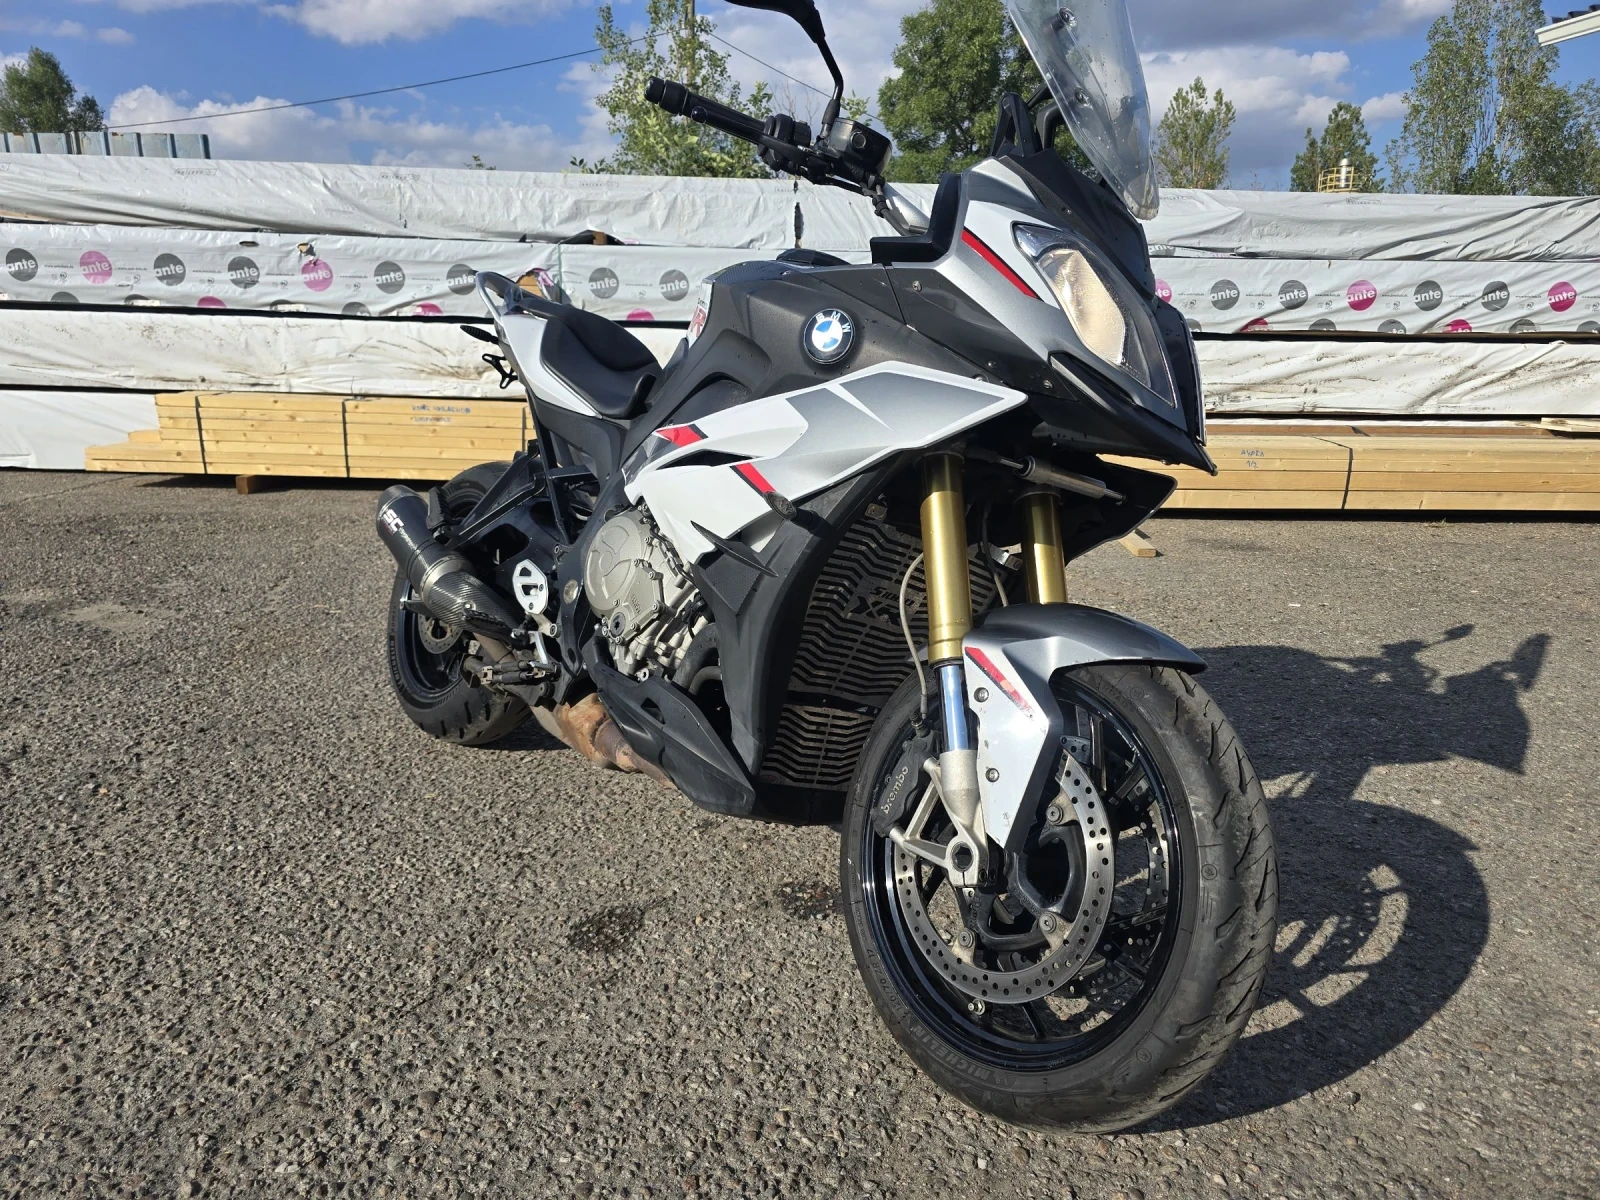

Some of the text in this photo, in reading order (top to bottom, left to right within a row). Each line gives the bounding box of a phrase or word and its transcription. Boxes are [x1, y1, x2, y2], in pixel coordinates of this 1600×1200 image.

[6, 259, 36, 272] ante
[81, 261, 110, 274] ante
[154, 264, 184, 277] ante
[228, 266, 258, 279] ante
[302, 269, 330, 282] ante
[375, 271, 403, 284] ante
[589, 278, 618, 289] ante
[659, 279, 688, 292] ante
[1210, 288, 1238, 302] ante
[1279, 289, 1307, 302] ante
[1347, 289, 1375, 302] ante
[1414, 290, 1441, 303] ante
[1481, 290, 1508, 303] ante
[1548, 291, 1576, 303] ante
[816, 311, 851, 333] BMW
[383, 509, 404, 532] SC
[881, 766, 909, 814] brembo
[911, 1025, 991, 1081] MICHELIN
